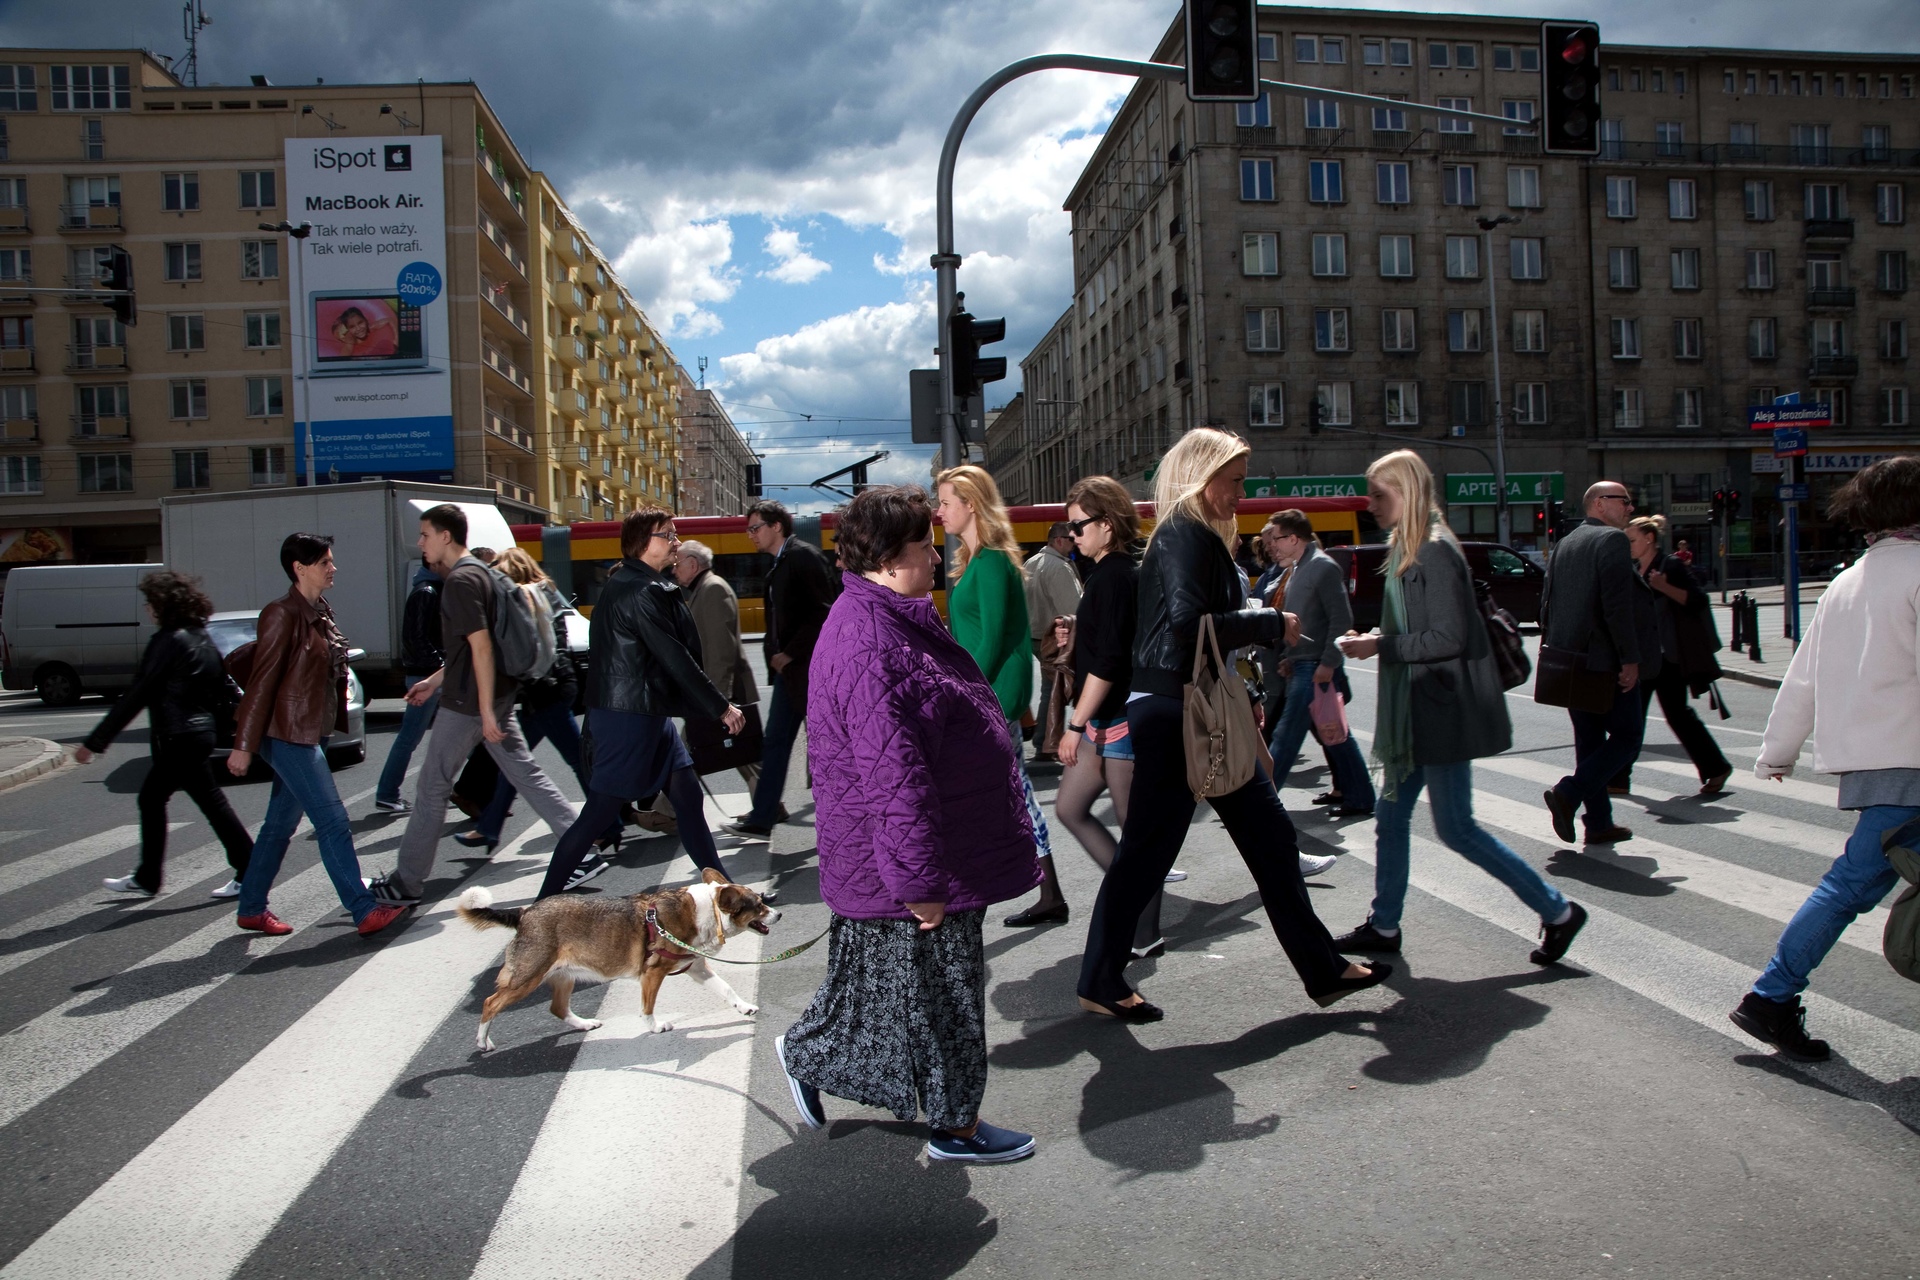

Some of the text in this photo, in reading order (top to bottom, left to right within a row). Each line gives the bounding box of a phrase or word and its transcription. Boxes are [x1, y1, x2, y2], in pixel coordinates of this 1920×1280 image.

[314, 148, 376, 173] iSpot
[306, 194, 424, 211] MacBook Air.
[314, 222, 417, 237] Tak mało waży.
[310, 240, 423, 256] Tak wiele potrafi.
[405, 273, 435, 284] RATY
[400, 284, 437, 296] 20x0%
[334, 392, 409, 403] www.ispot.com.pl
[1754, 409, 1829, 423] Aleje Jerozolimskie
[315, 434, 362, 443] Zapraszamy
[376, 432, 408, 440] salonów
[410, 430, 431, 439] iSpot
[1290, 484, 1357, 497] APTEKA
